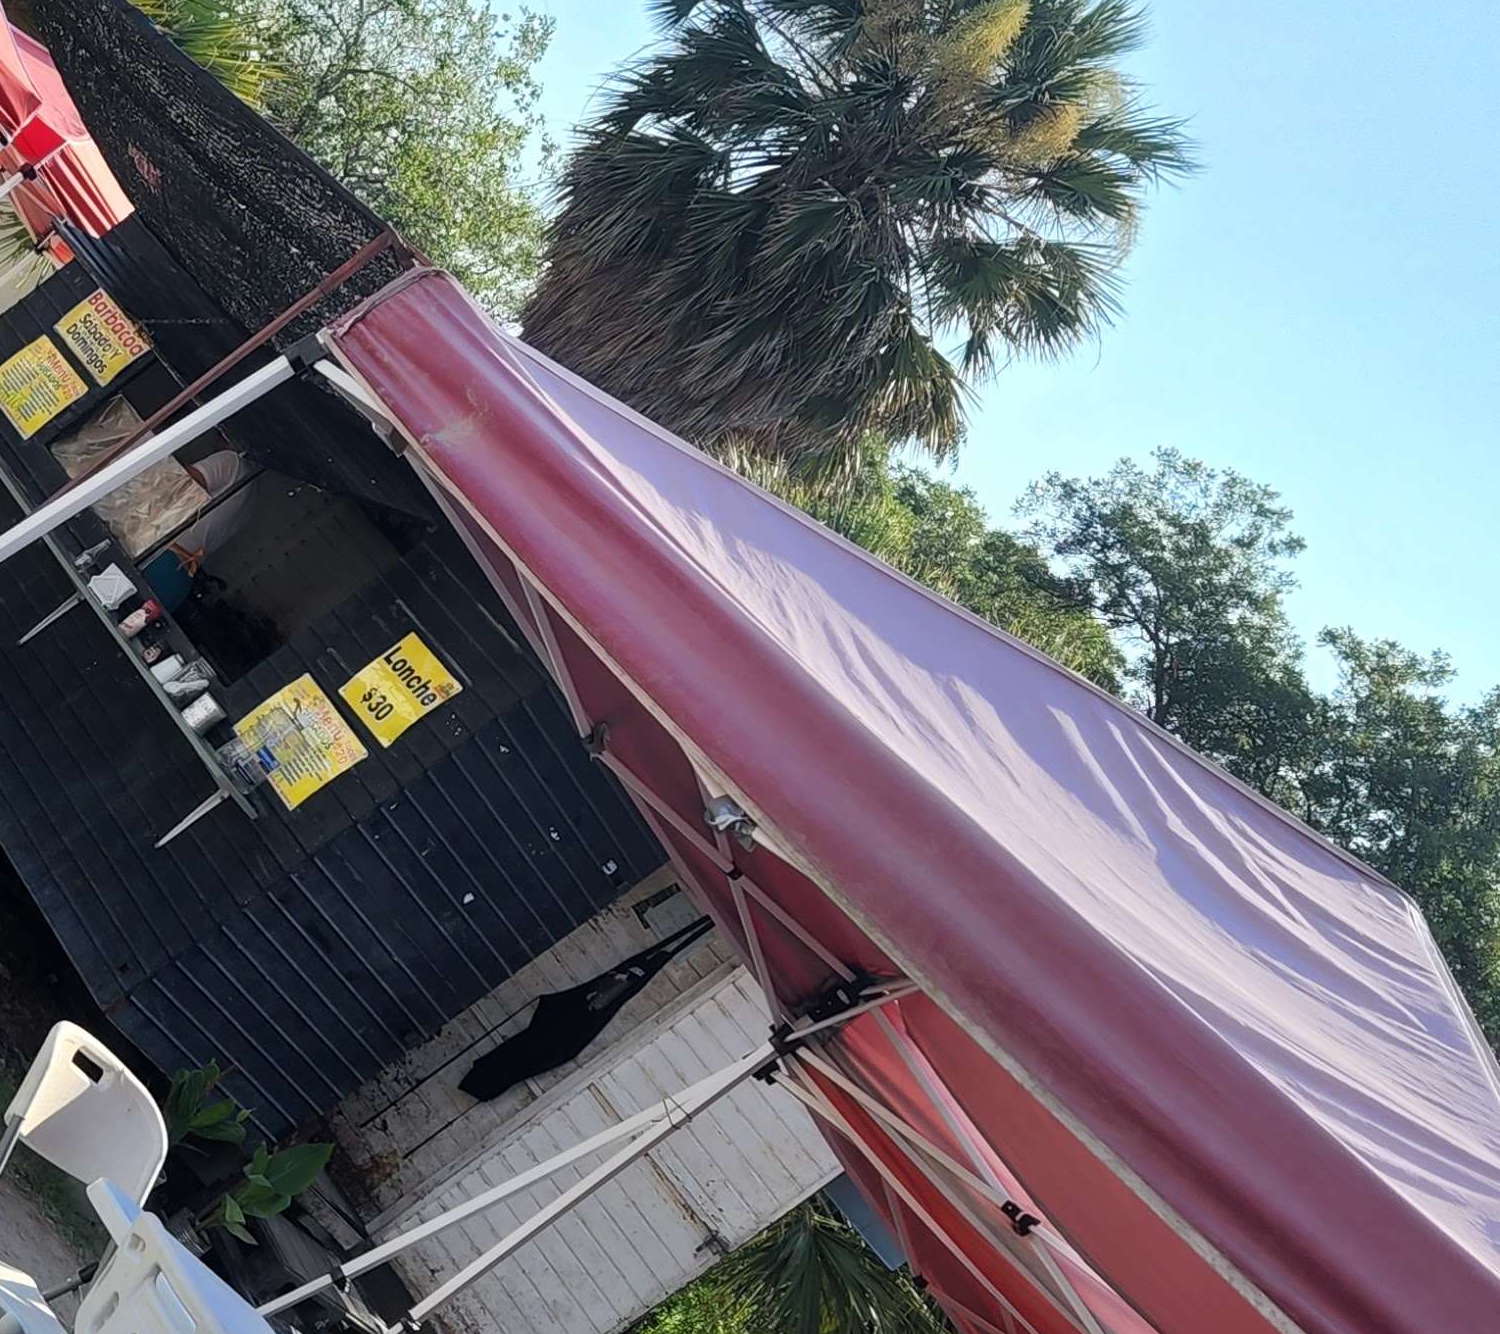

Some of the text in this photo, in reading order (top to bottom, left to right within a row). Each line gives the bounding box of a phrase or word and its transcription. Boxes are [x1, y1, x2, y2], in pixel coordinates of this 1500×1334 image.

[63, 321, 110, 376] Domingos
[77, 311, 122, 363] Sábado Y
[86, 289, 146, 359] Barbacoa
[46, 356, 74, 384] Menú
[382, 643, 440, 709] Lonche
[357, 683, 396, 724] $30
